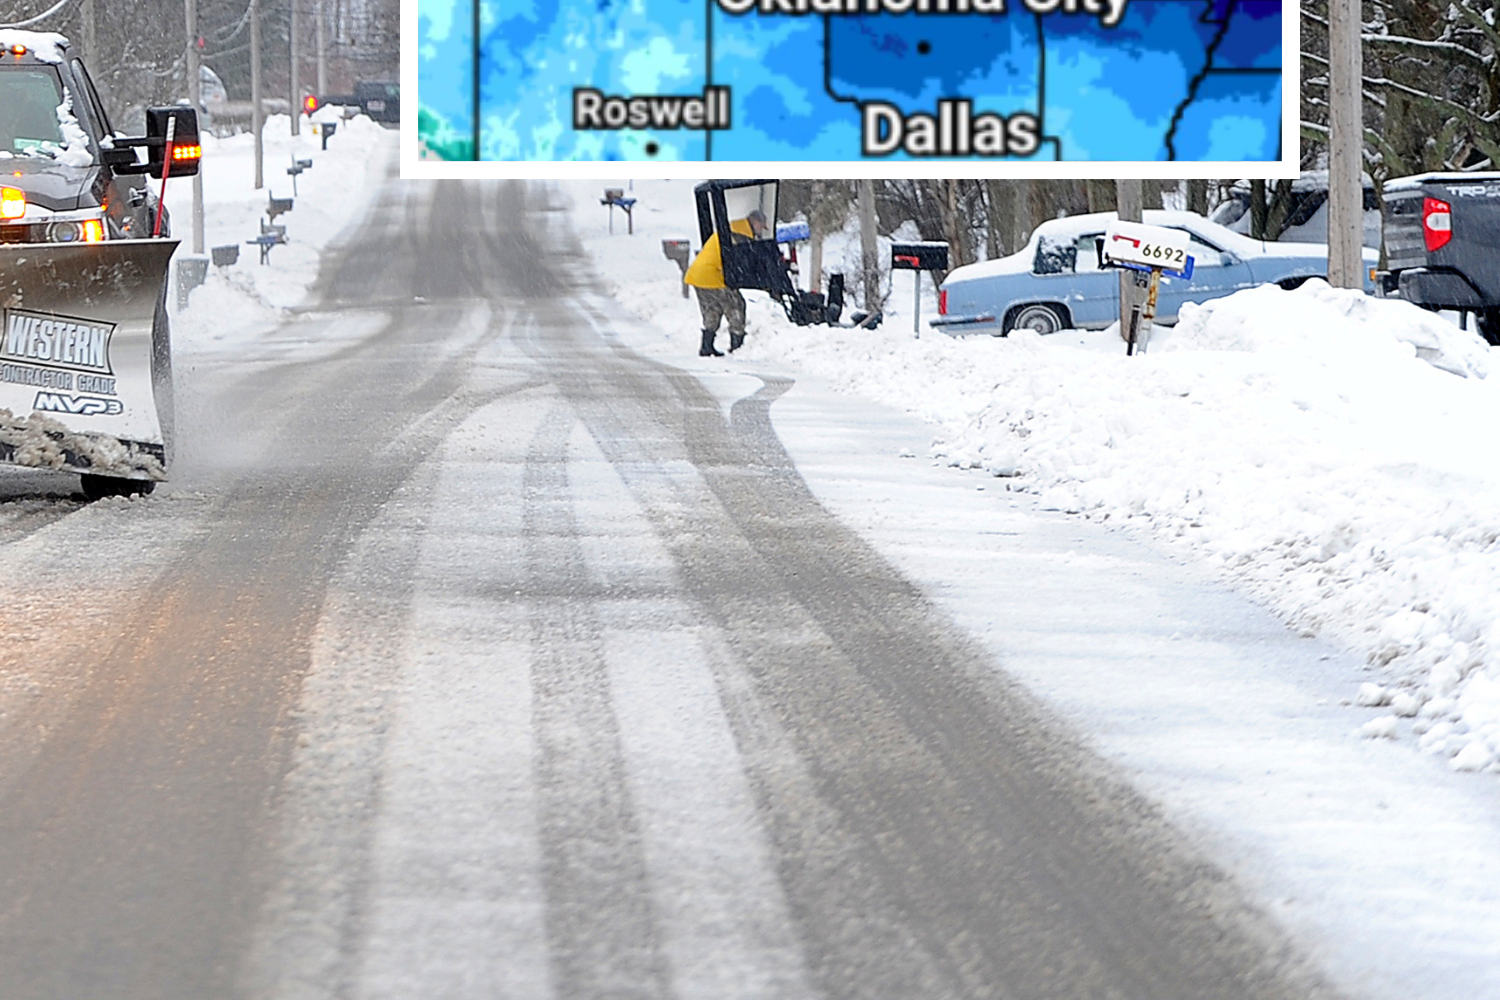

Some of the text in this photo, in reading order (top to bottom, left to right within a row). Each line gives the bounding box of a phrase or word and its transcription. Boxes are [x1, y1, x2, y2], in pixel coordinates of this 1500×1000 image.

[1445, 185, 1486, 198] TRD
[1142, 243, 1185, 263] 6692
[7, 314, 107, 368] WESTERN
[77, 375, 118, 396] GRADE
[34, 391, 123, 415] MVP3
